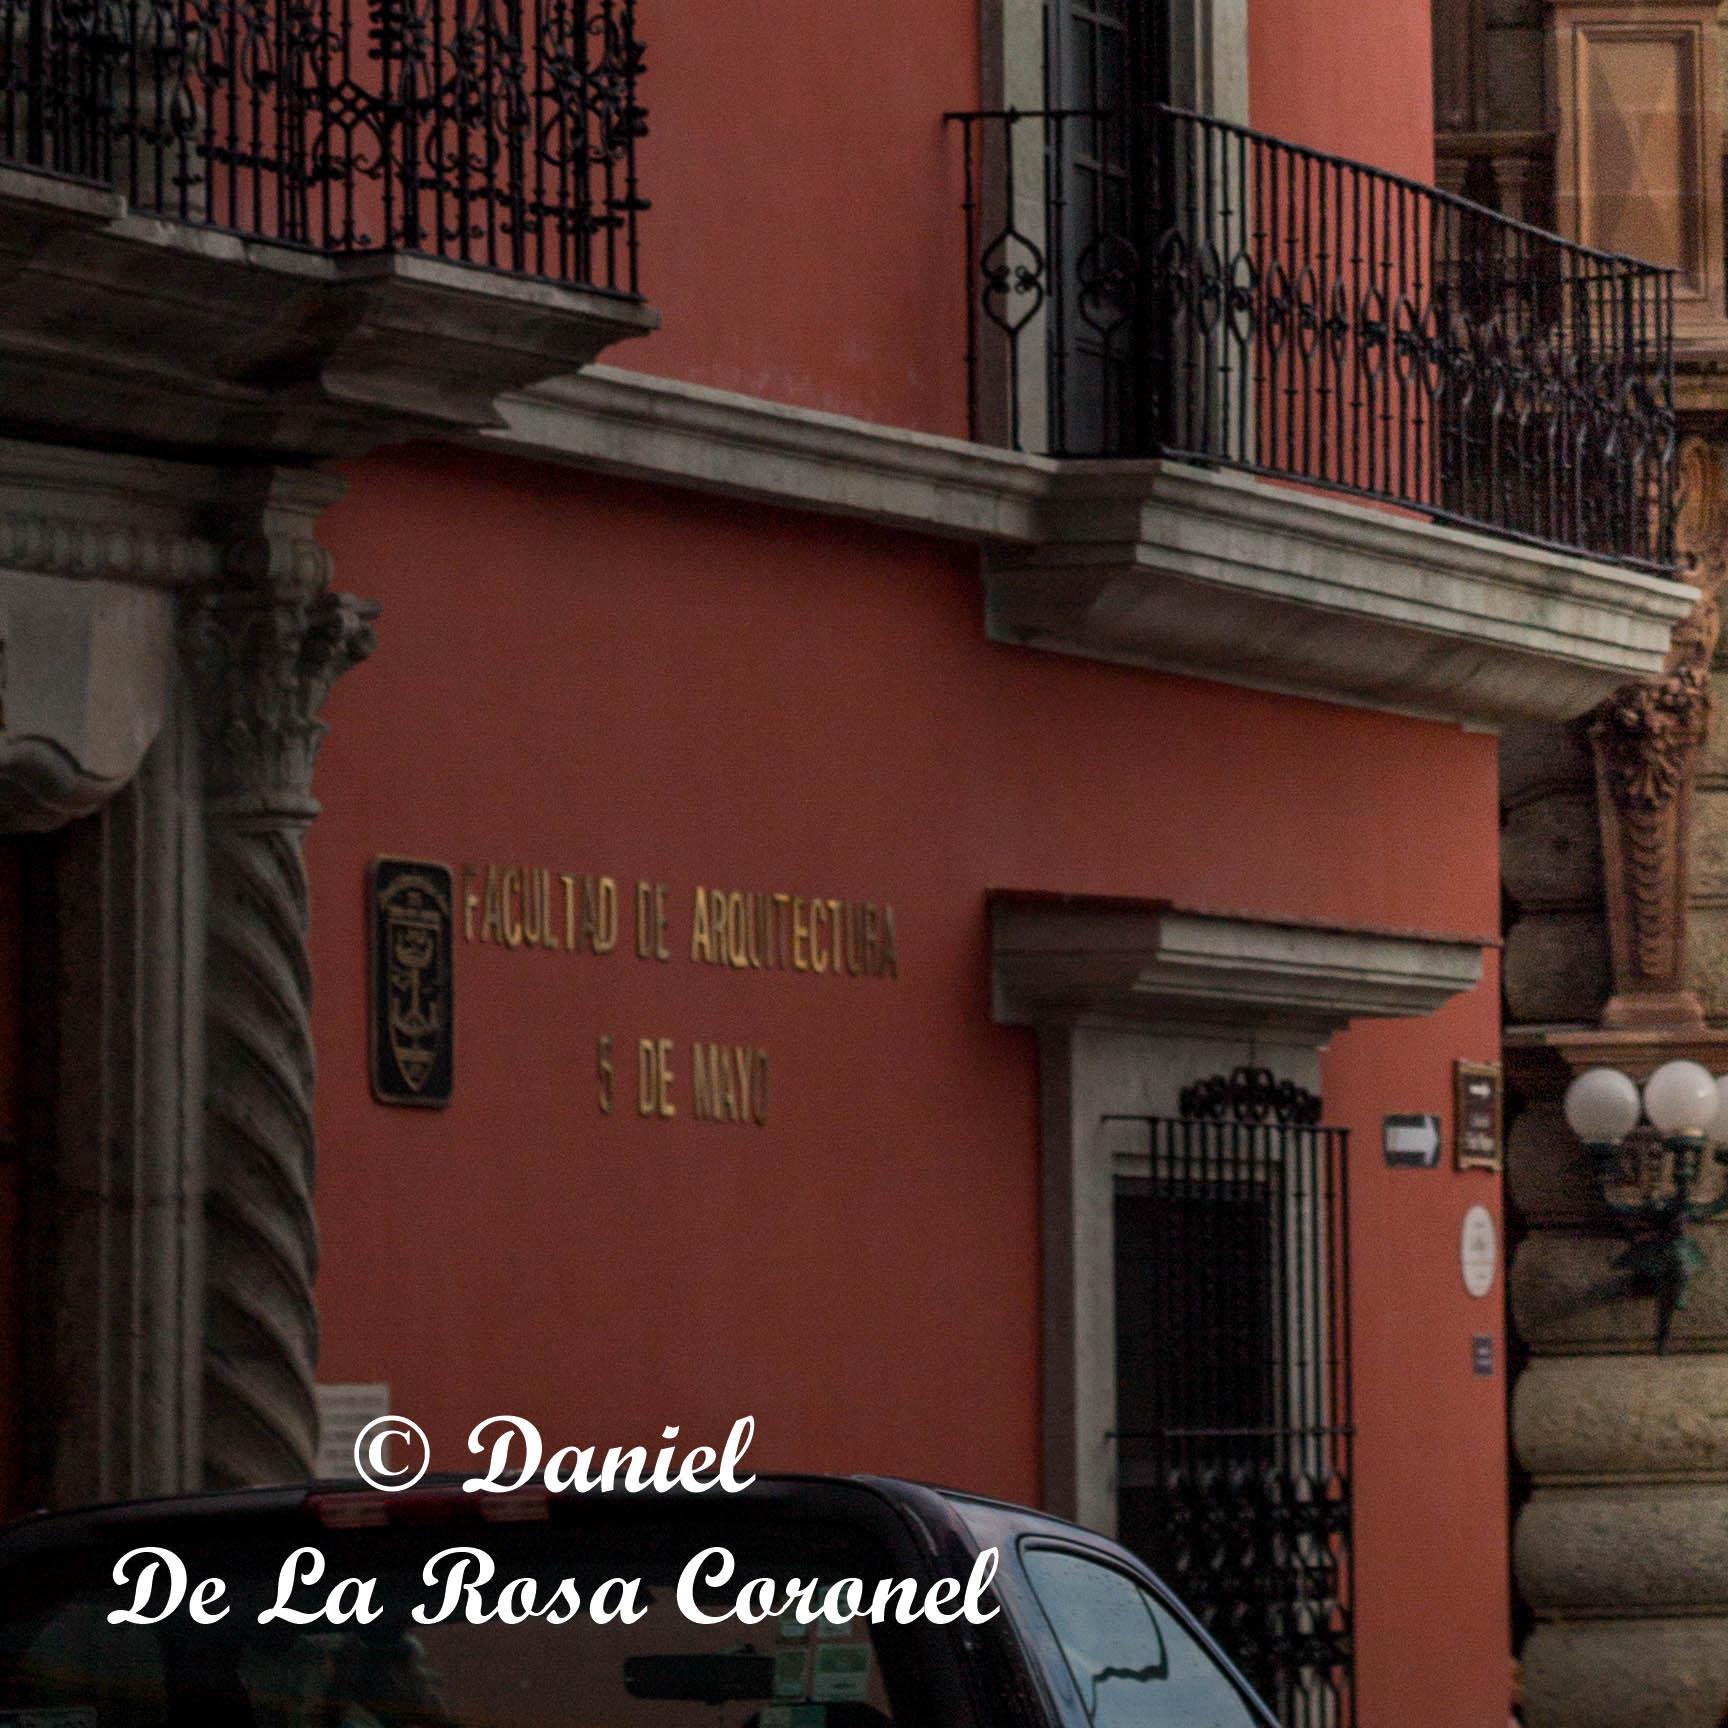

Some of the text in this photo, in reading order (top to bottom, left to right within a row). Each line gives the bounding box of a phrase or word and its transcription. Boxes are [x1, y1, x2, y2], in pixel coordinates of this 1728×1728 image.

[462, 863, 899, 978] FACULTAD DE ARQUITECTURA
[597, 1035, 770, 1125] 5 DE MAYO
